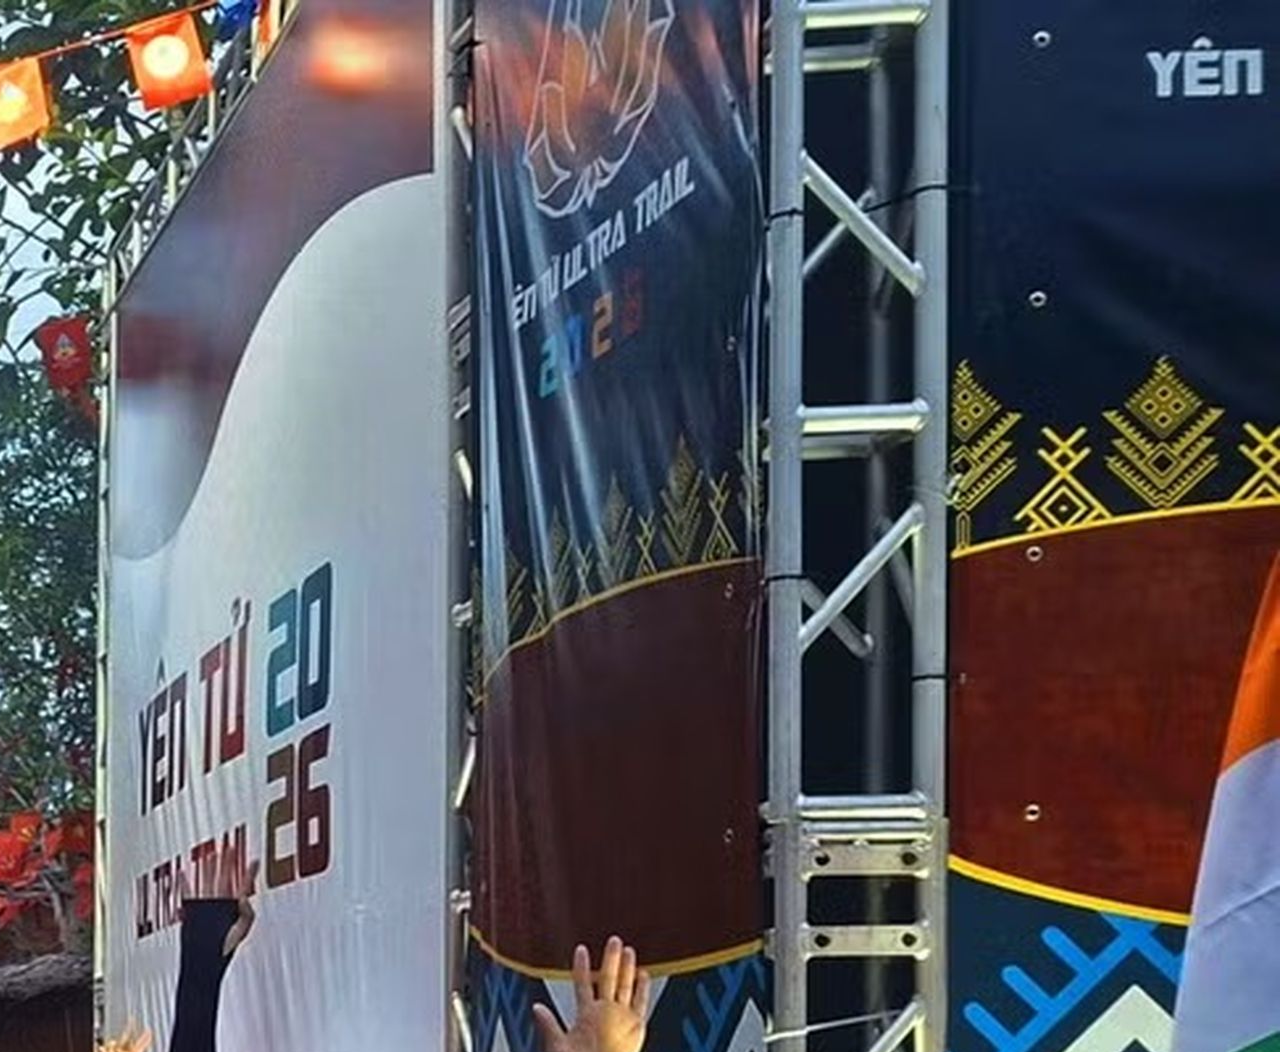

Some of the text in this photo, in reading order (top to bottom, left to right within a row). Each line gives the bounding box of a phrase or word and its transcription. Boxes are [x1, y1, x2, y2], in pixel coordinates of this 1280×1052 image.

[1146, 36, 1263, 97] YÊN
[563, 210, 626, 291] ULTRA
[634, 156, 694, 233] TRAIL
[139, 596, 251, 817] YÊN TỬ
[266, 560, 332, 738] 20
[266, 722, 331, 890] 26
